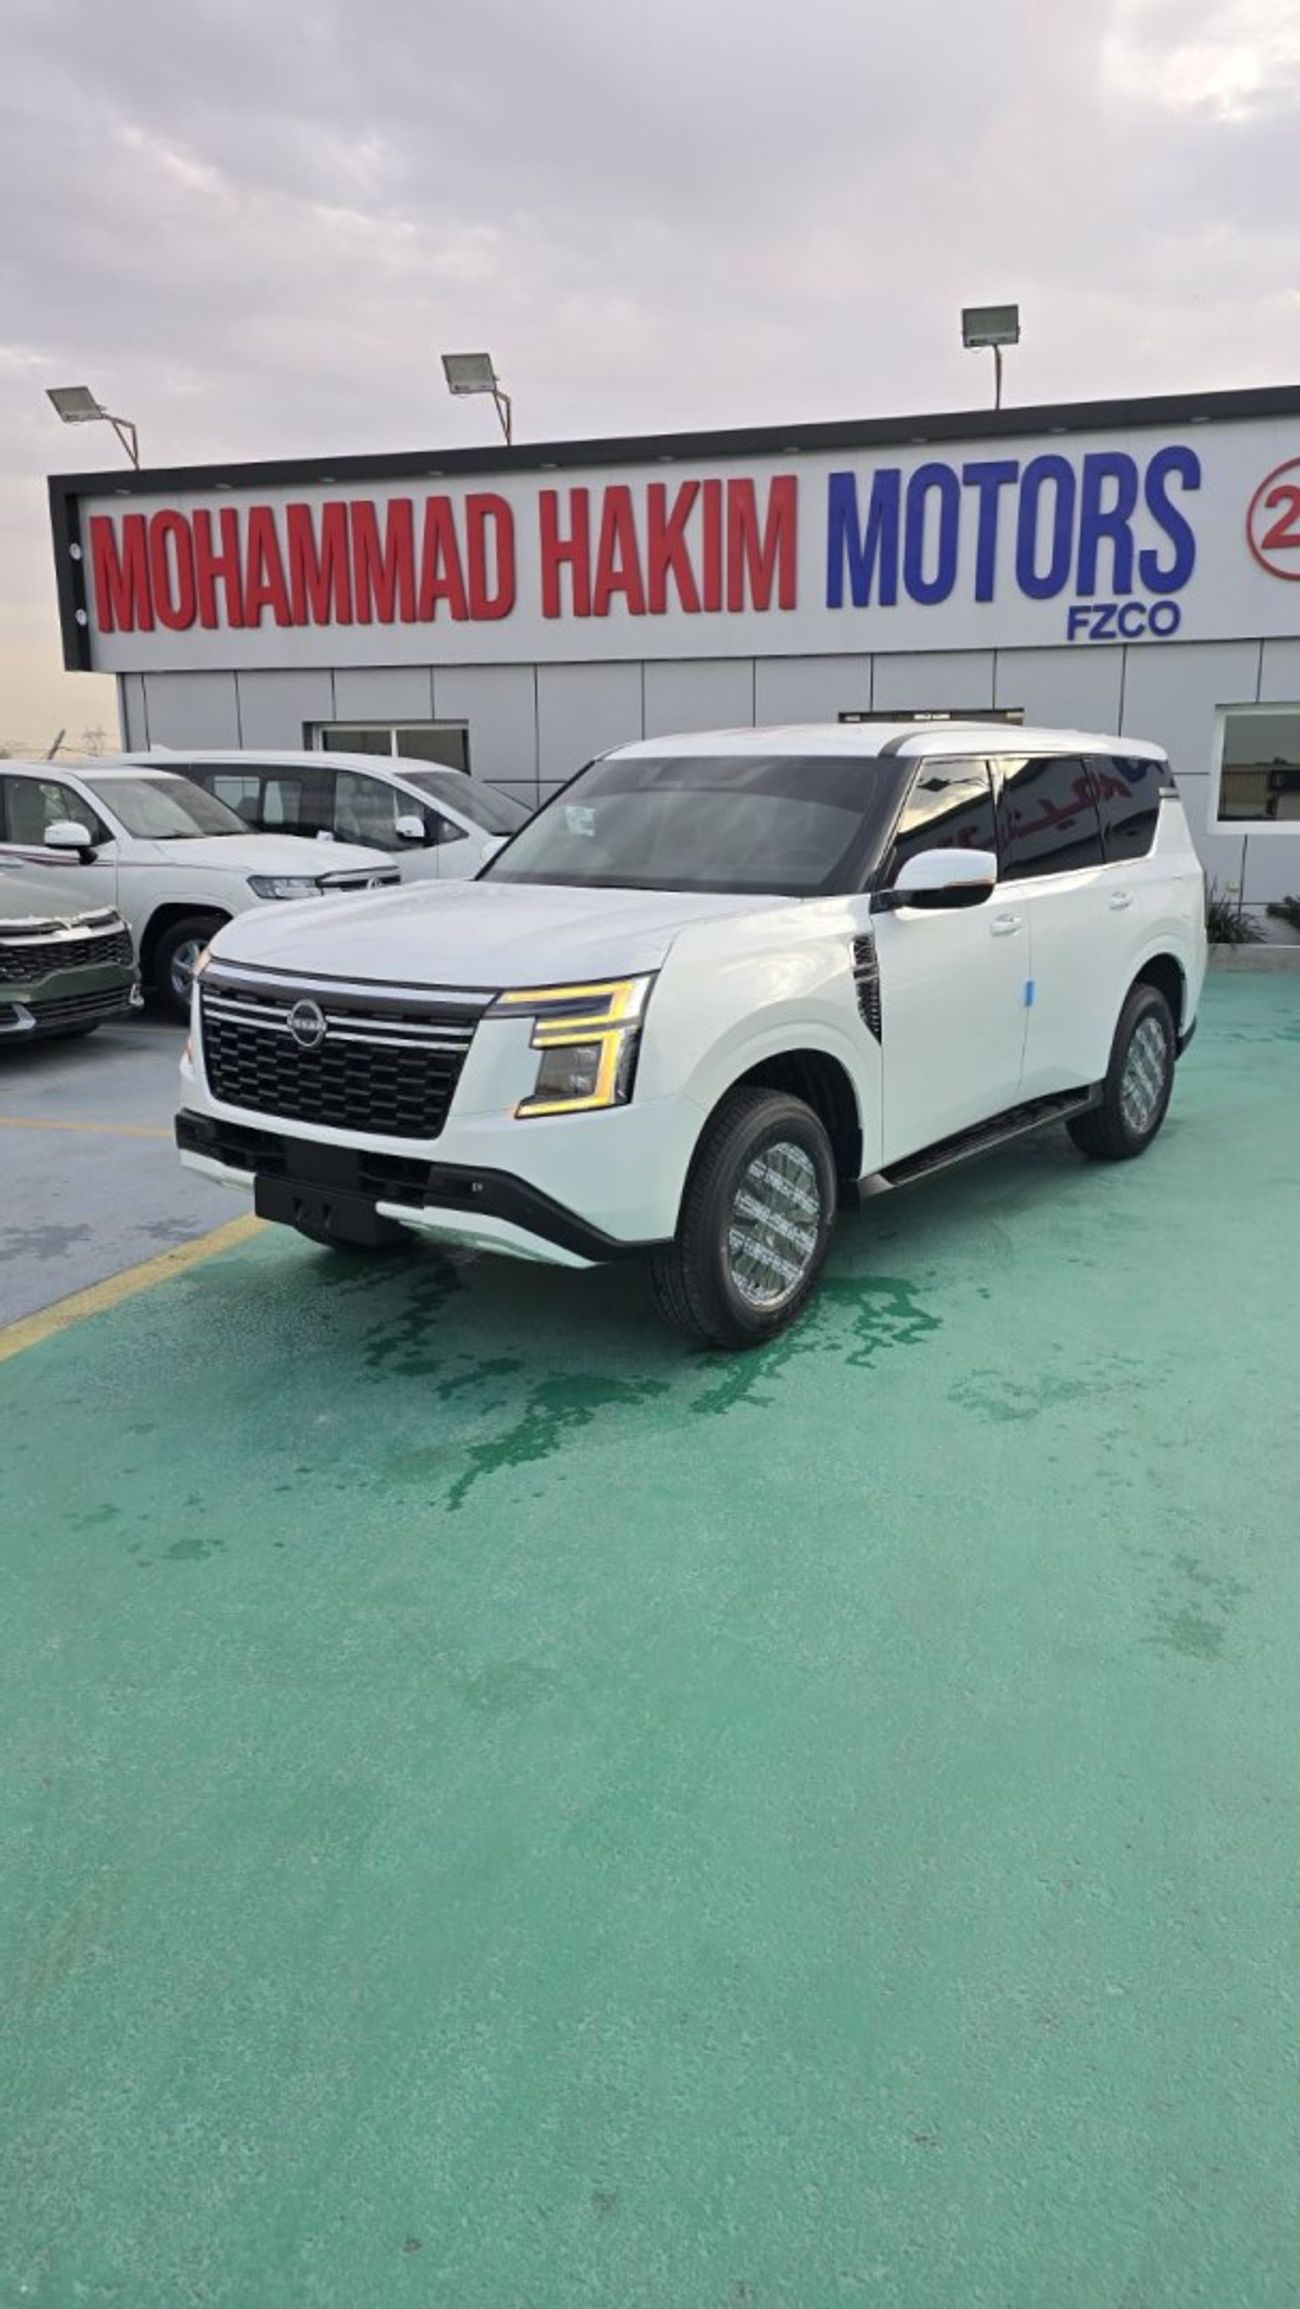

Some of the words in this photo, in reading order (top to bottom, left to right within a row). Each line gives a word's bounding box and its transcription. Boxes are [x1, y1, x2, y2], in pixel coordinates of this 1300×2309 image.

[89, 493, 516, 633] MOHAMMAD
[538, 475, 797, 617] HAKIM
[826, 445, 1201, 608] MOTORS
[1067, 601, 1181, 641] FZCO
